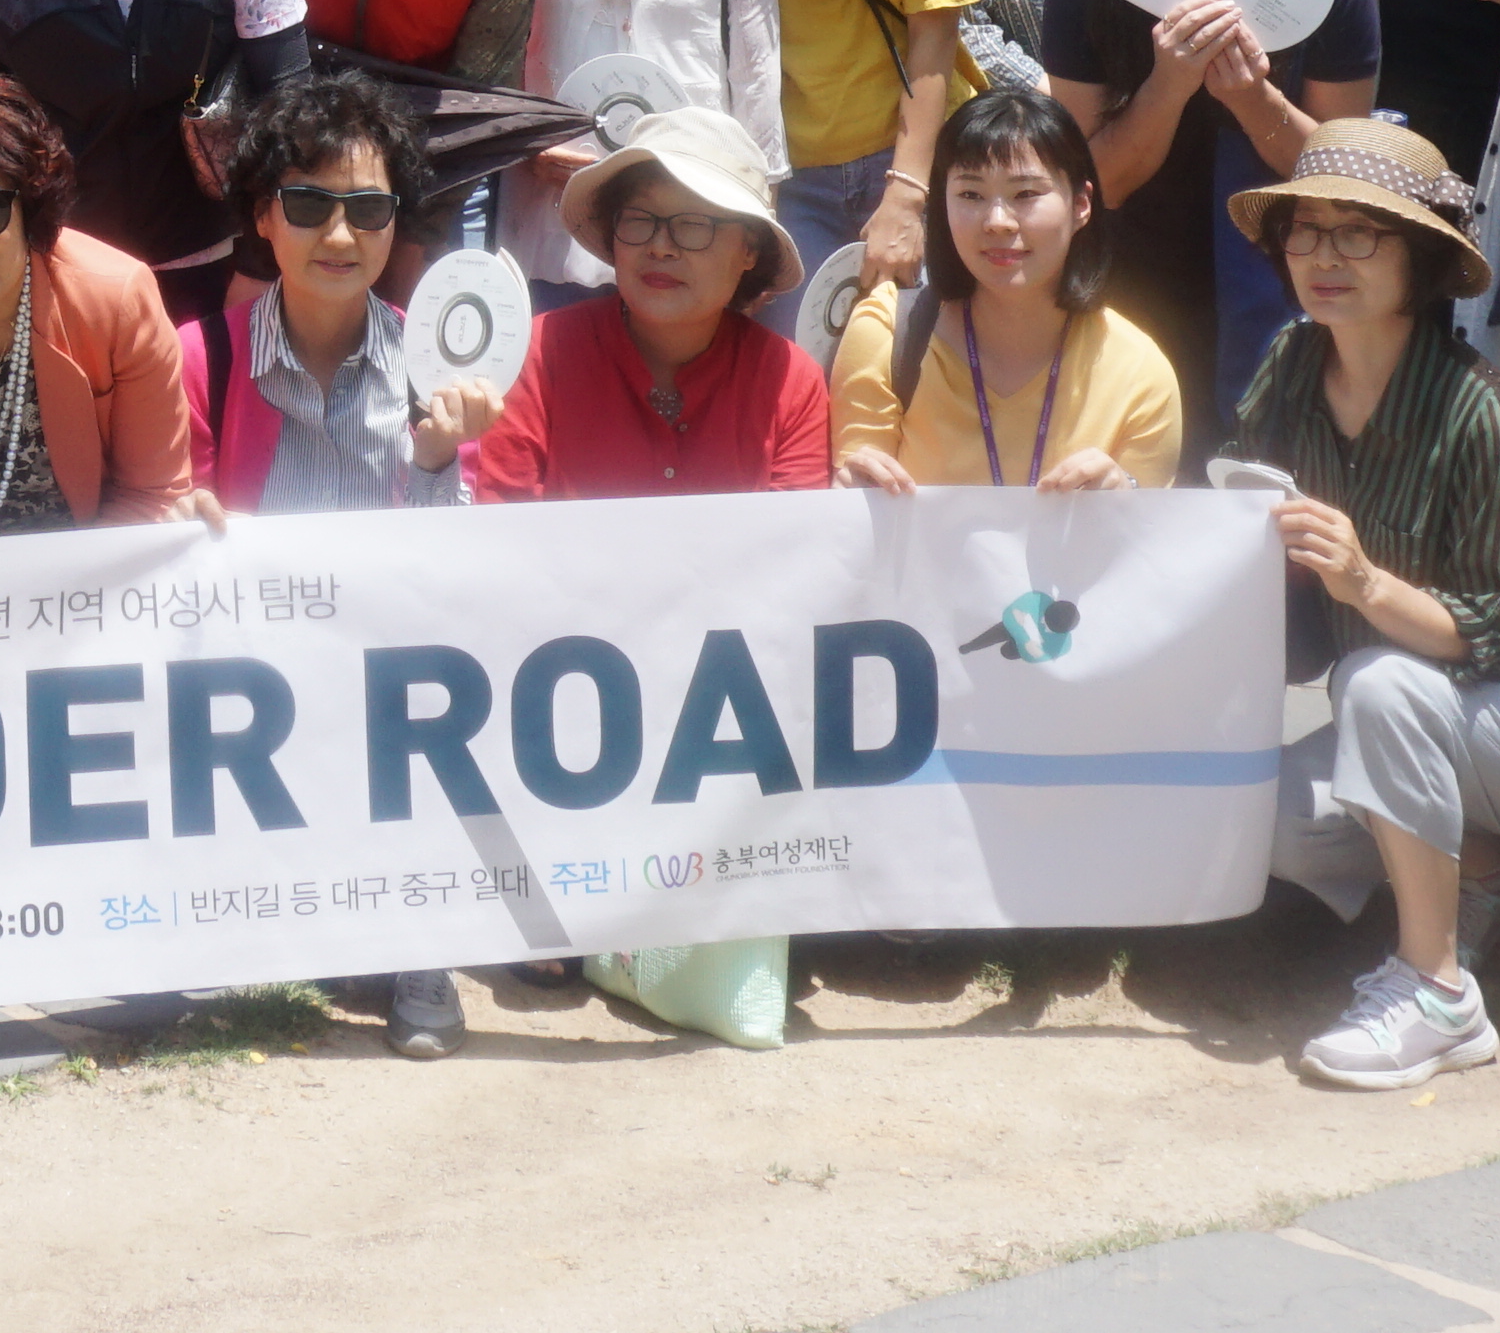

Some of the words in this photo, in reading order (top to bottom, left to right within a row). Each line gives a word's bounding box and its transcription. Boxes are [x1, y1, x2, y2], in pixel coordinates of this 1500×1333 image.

[26, 588, 105, 635] 지역
[120, 578, 244, 629] 여성사
[258, 573, 342, 622] 탐방
[363, 618, 940, 823] ROAD
[550, 858, 611, 896] 주관
[712, 835, 852, 874] 충북여성재단
[99, 894, 161, 931] 장소
[191, 883, 281, 924] 반지길
[289, 882, 320, 916] 등
[331, 876, 391, 913] 대구
[398, 870, 461, 907] 중구
[470, 864, 530, 900] 일대
